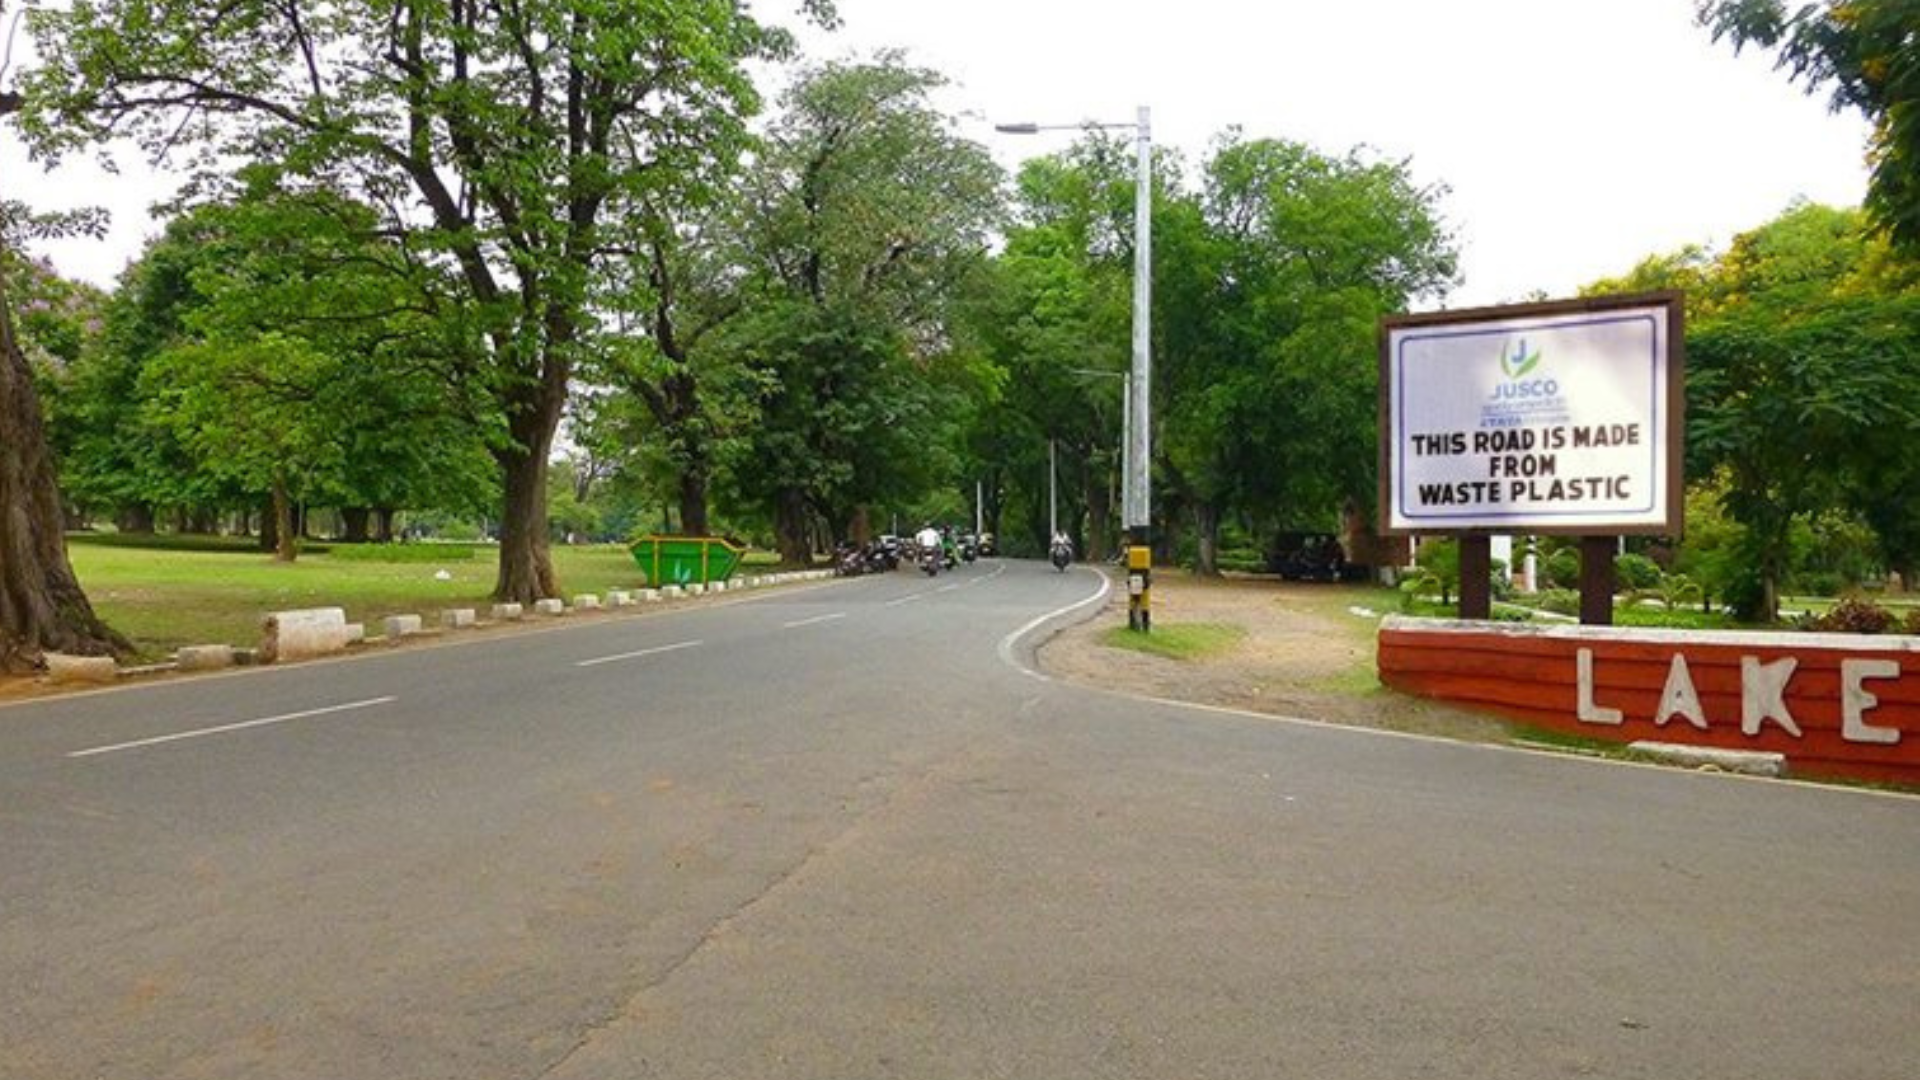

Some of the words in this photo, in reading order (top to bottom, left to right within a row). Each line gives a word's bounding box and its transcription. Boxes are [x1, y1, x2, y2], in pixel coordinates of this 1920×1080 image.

[1490, 379, 1558, 399] JUSCO
[1412, 433, 1466, 455] THIS
[1474, 429, 1535, 453] ROAD
[1543, 426, 1565, 449] IS
[1573, 423, 1640, 447] MADE
[1489, 454, 1556, 478] FROM
[1419, 481, 1500, 505] WASTE
[1510, 475, 1631, 502] PLASTIC
[1576, 647, 1901, 744] LAKE
